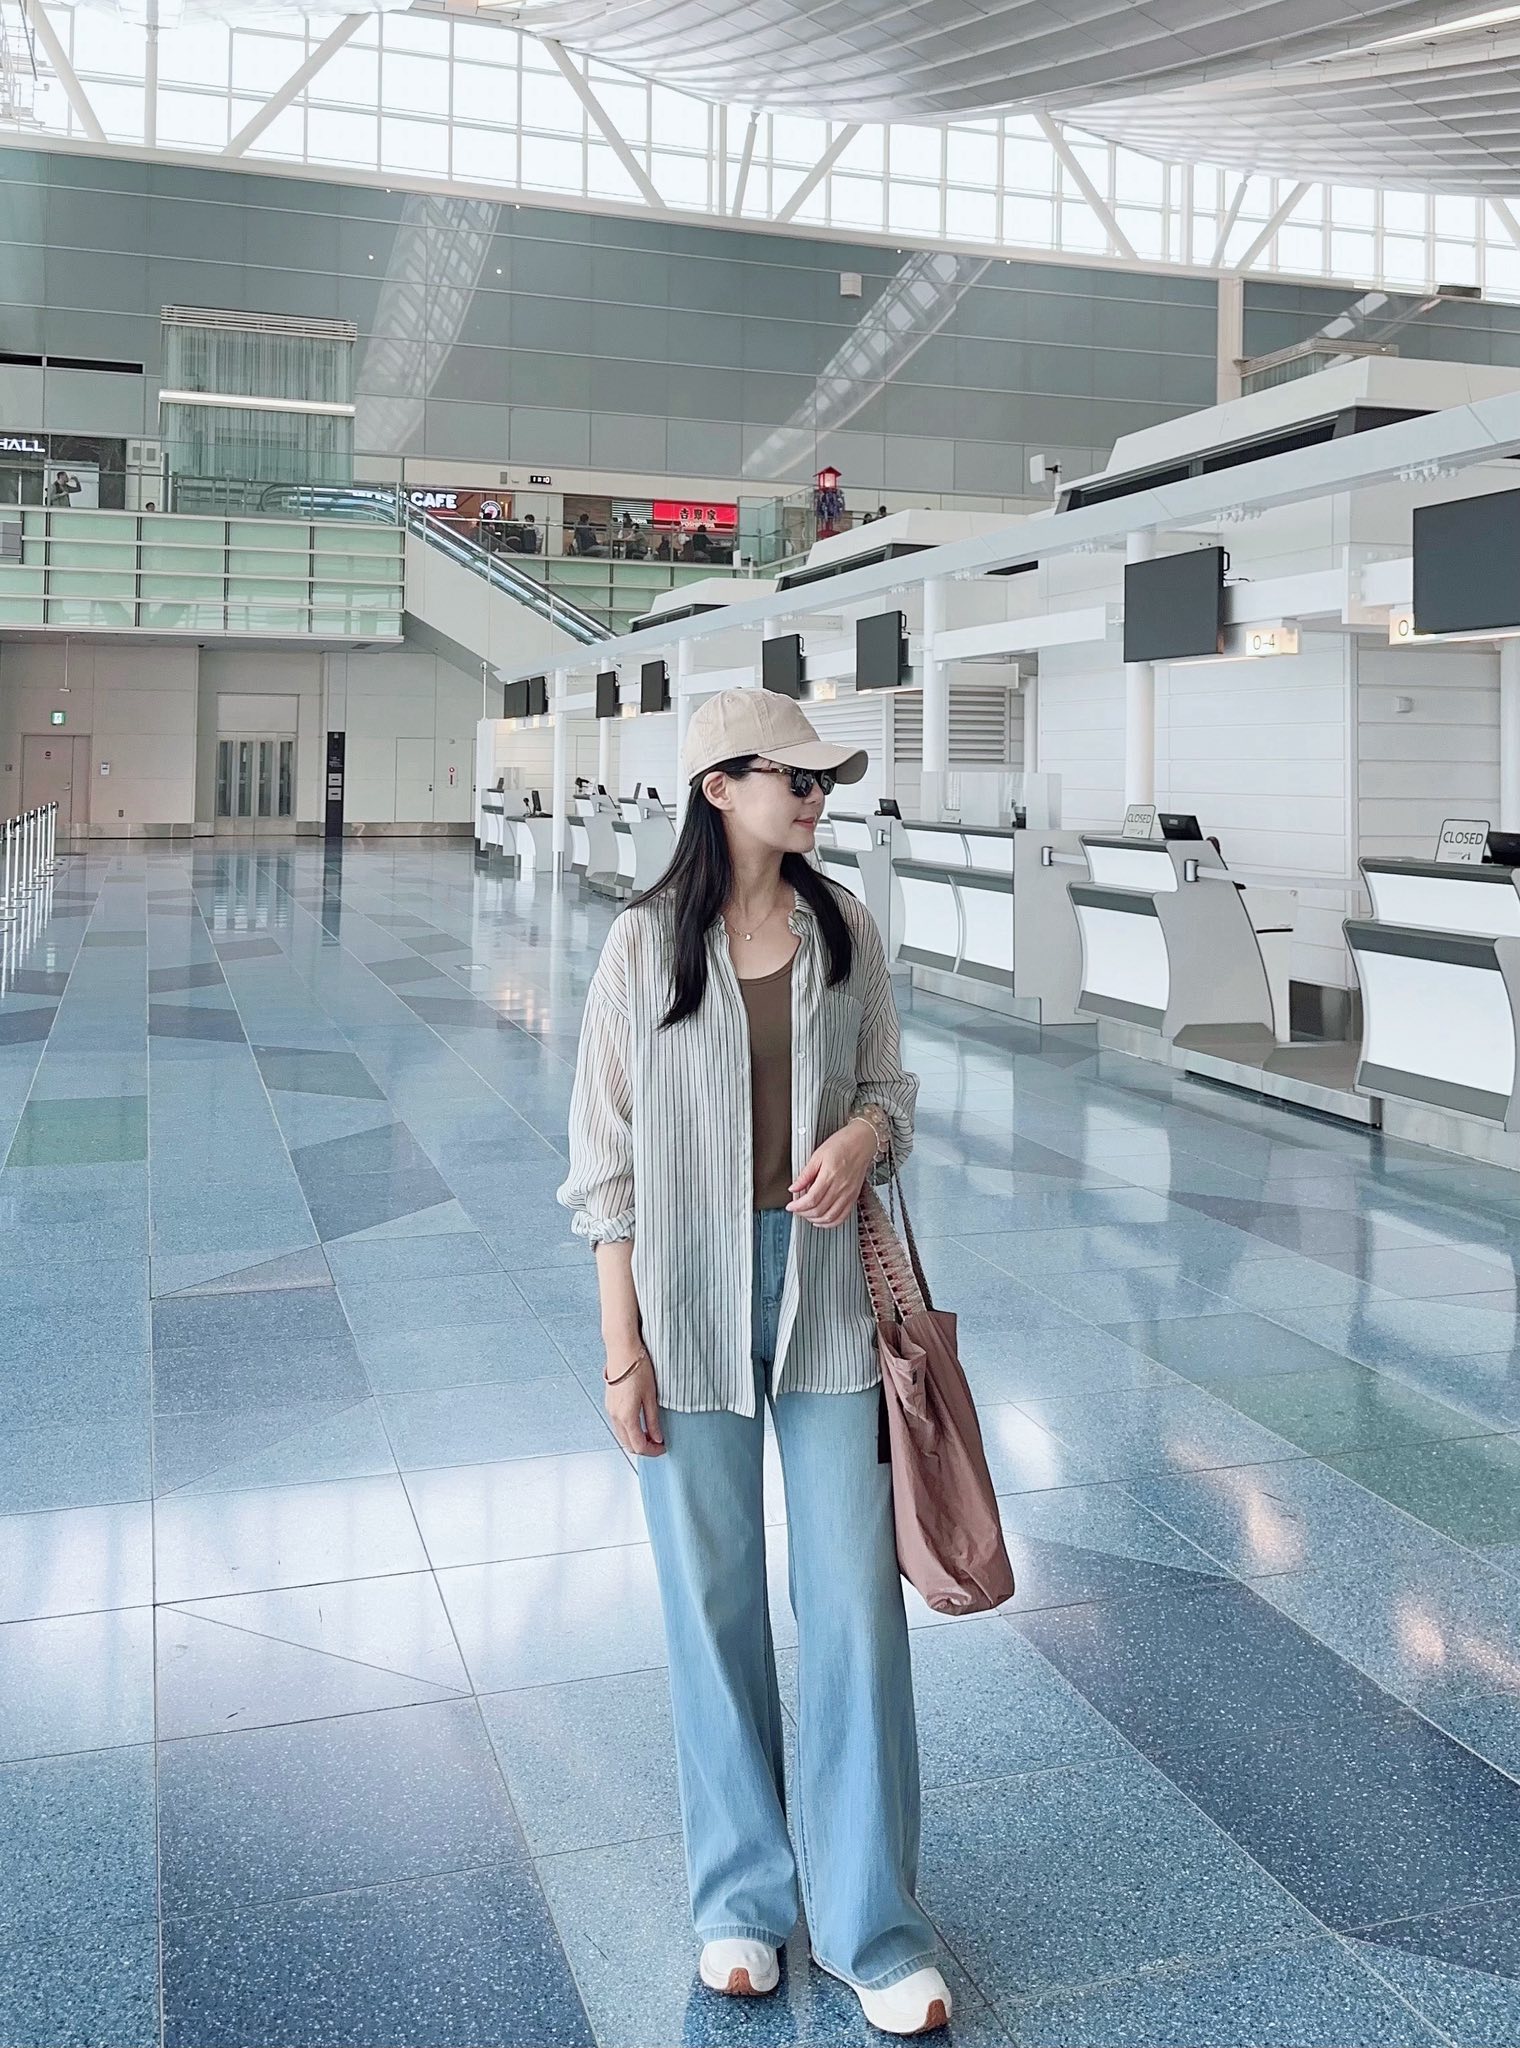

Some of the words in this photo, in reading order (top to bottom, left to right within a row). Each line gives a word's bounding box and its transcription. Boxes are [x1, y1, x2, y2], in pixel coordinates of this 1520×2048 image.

[410, 491, 457, 509] CAFE
[1127, 813, 1152, 824] CLOSED
[1443, 831, 1484, 845] CLOSED
